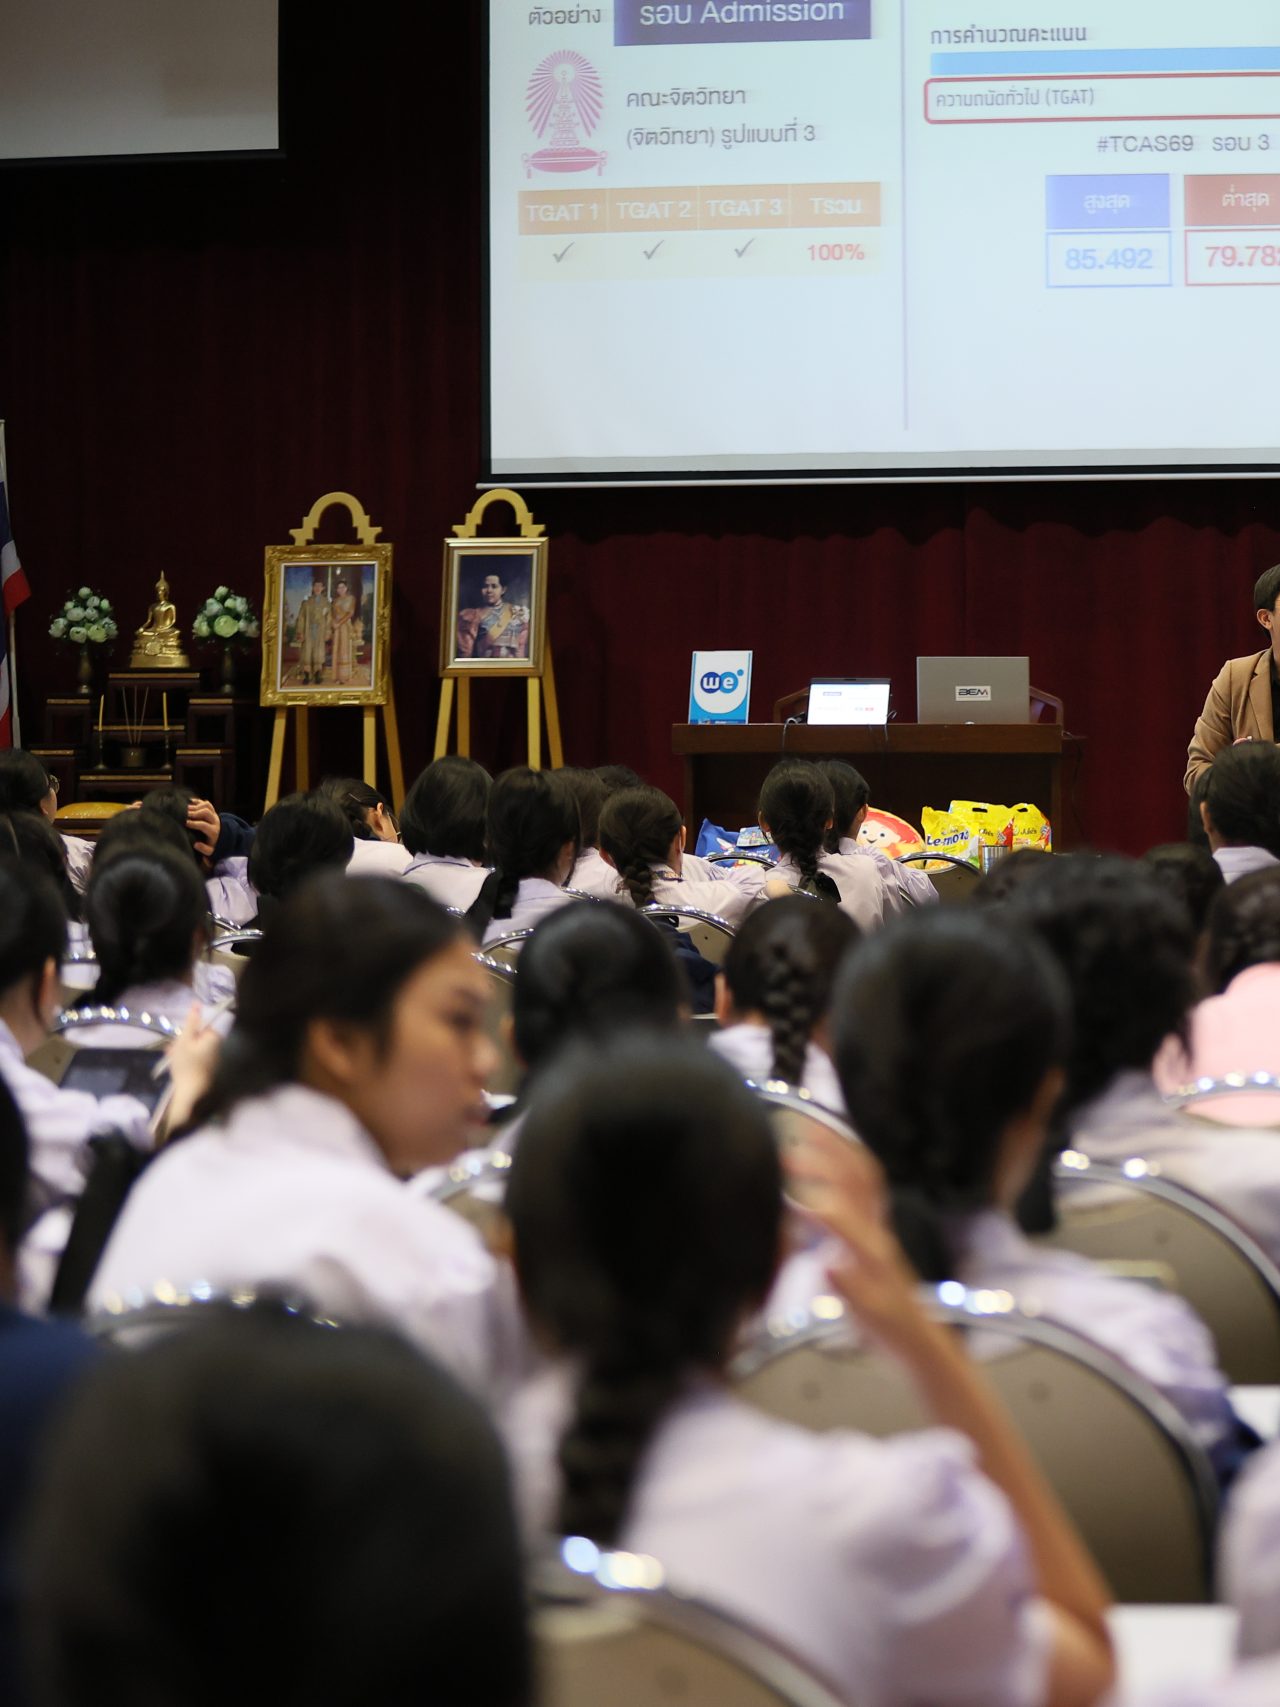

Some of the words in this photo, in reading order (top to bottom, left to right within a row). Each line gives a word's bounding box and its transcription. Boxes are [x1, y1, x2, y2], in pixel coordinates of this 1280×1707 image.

[528, 6, 602, 26] ตัวอย่าง
[639, 3, 692, 25] รอบ
[700, 0, 845, 23] Admission
[930, 23, 1088, 44] การคำนวณคะแนน
[626, 86, 747, 107] คณะจิตวิทยา
[936, 84, 1041, 106] ความถนัดทั่วไป
[1045, 87, 1095, 106] (TGAT)
[626, 126, 716, 150] (จิตวิทยา)
[720, 117, 798, 150] รูปแบบที่
[803, 124, 816, 142] 3
[1096, 134, 1194, 153] #TCAS69
[1211, 136, 1251, 151] รอบ
[1257, 133, 1271, 151] 3
[706, 199, 764, 218] TGAT
[769, 197, 783, 216] 3
[809, 196, 863, 215] Tรวม
[1083, 192, 1131, 214] สูงสุด
[1221, 184, 1271, 212] ต่ำสุด
[526, 203, 584, 223] TGAT
[589, 202, 599, 221] 1
[616, 201, 674, 220] TGAT
[679, 200, 692, 219] 2
[807, 243, 866, 262] 100%
[1065, 247, 1153, 271] 85.492
